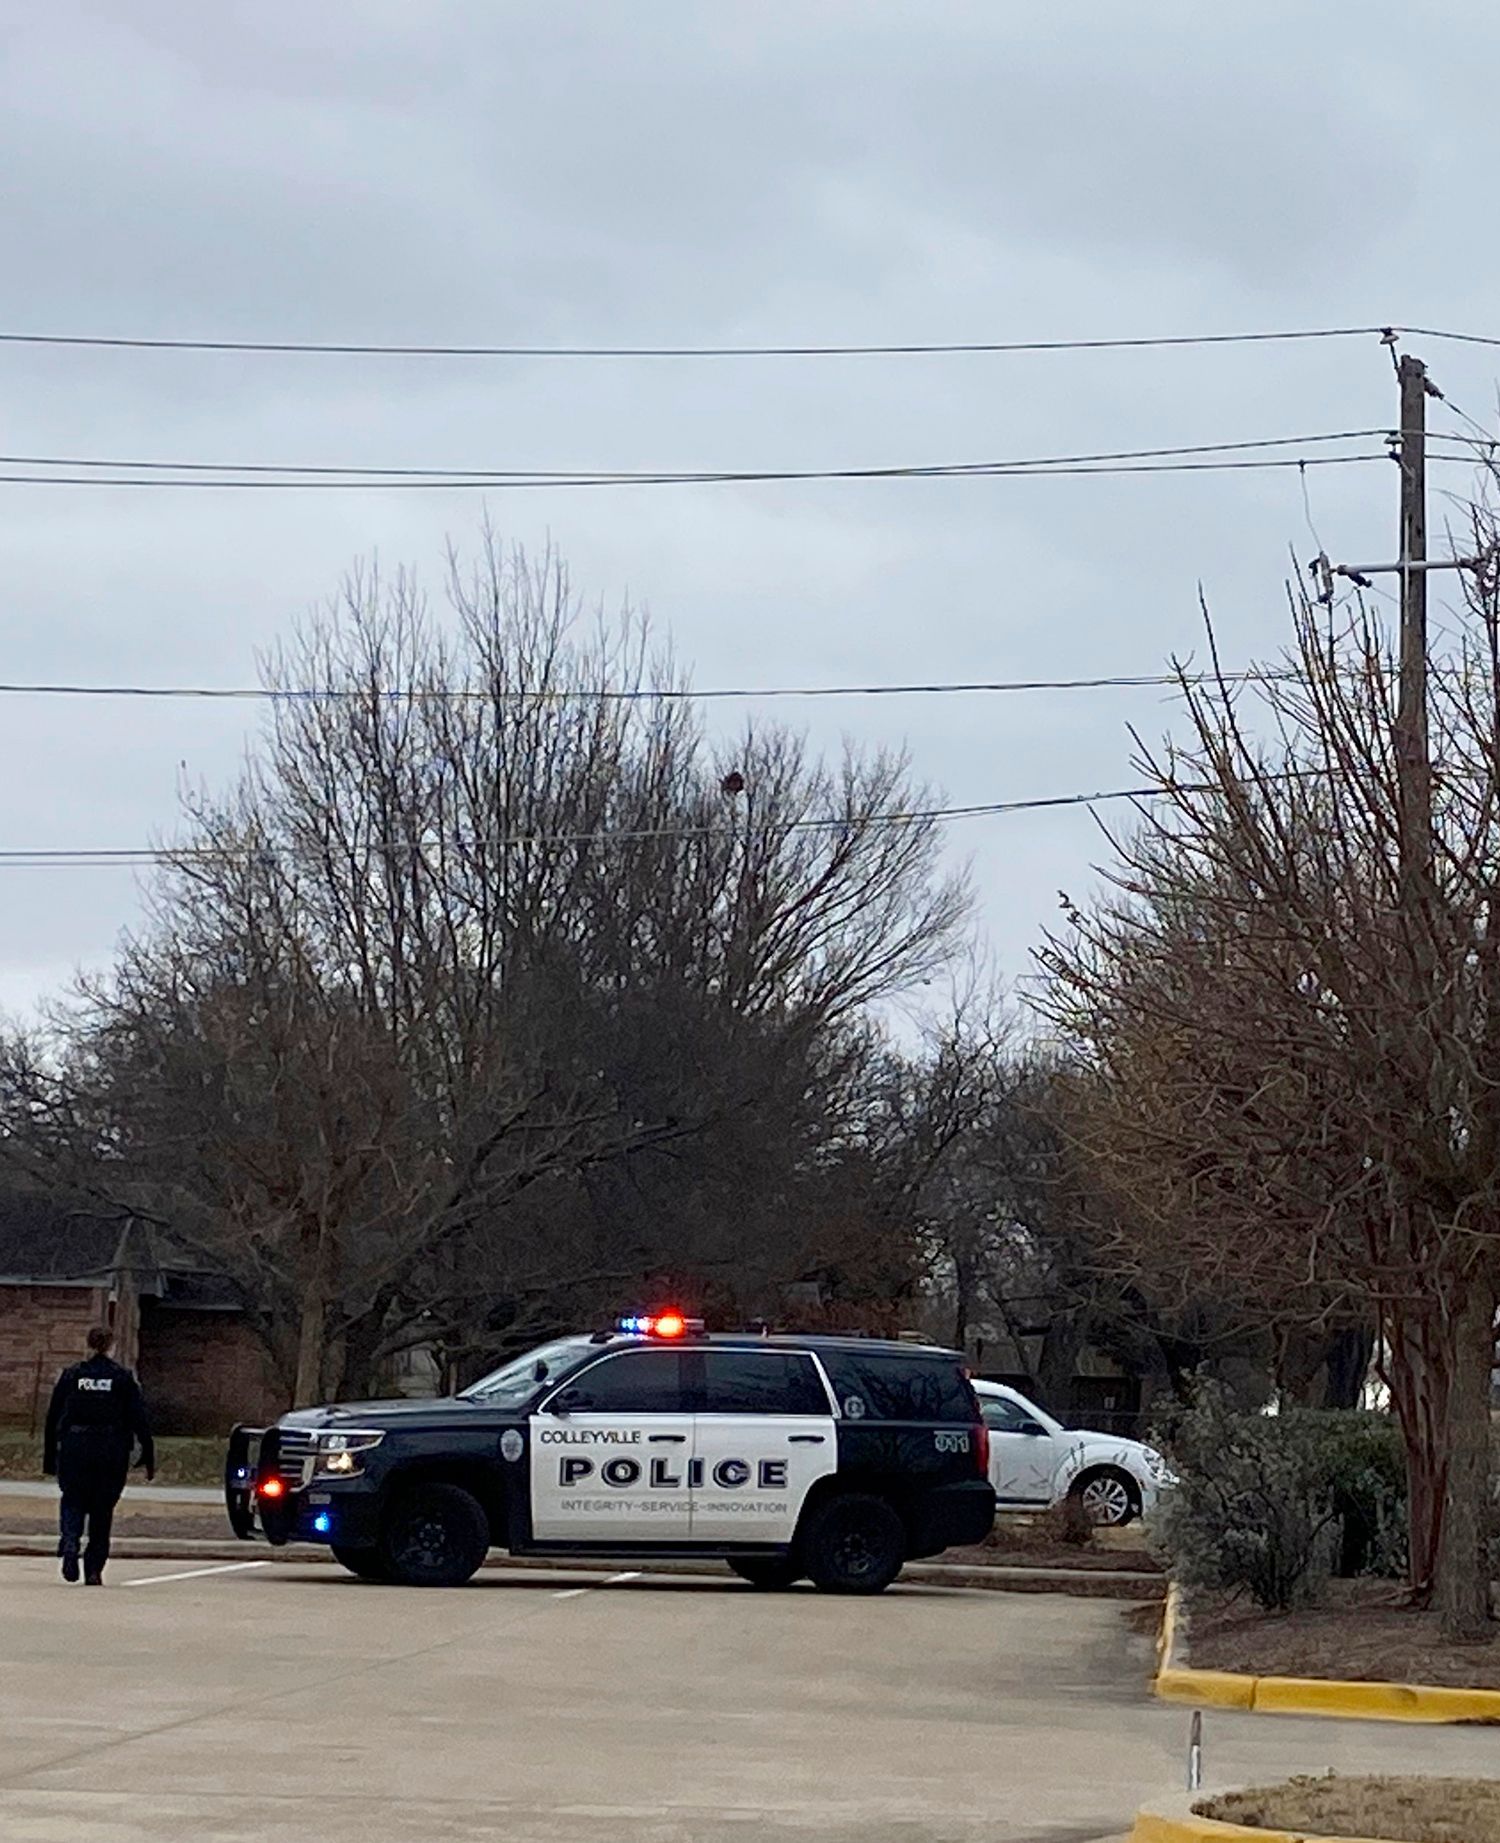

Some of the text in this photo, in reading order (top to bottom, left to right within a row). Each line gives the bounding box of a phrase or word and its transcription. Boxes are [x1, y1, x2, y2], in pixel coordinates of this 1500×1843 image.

[78, 1378, 113, 1391] POLICE
[540, 1431, 641, 1444] COLLEYVILLE
[559, 1456, 788, 1488] POLICE
